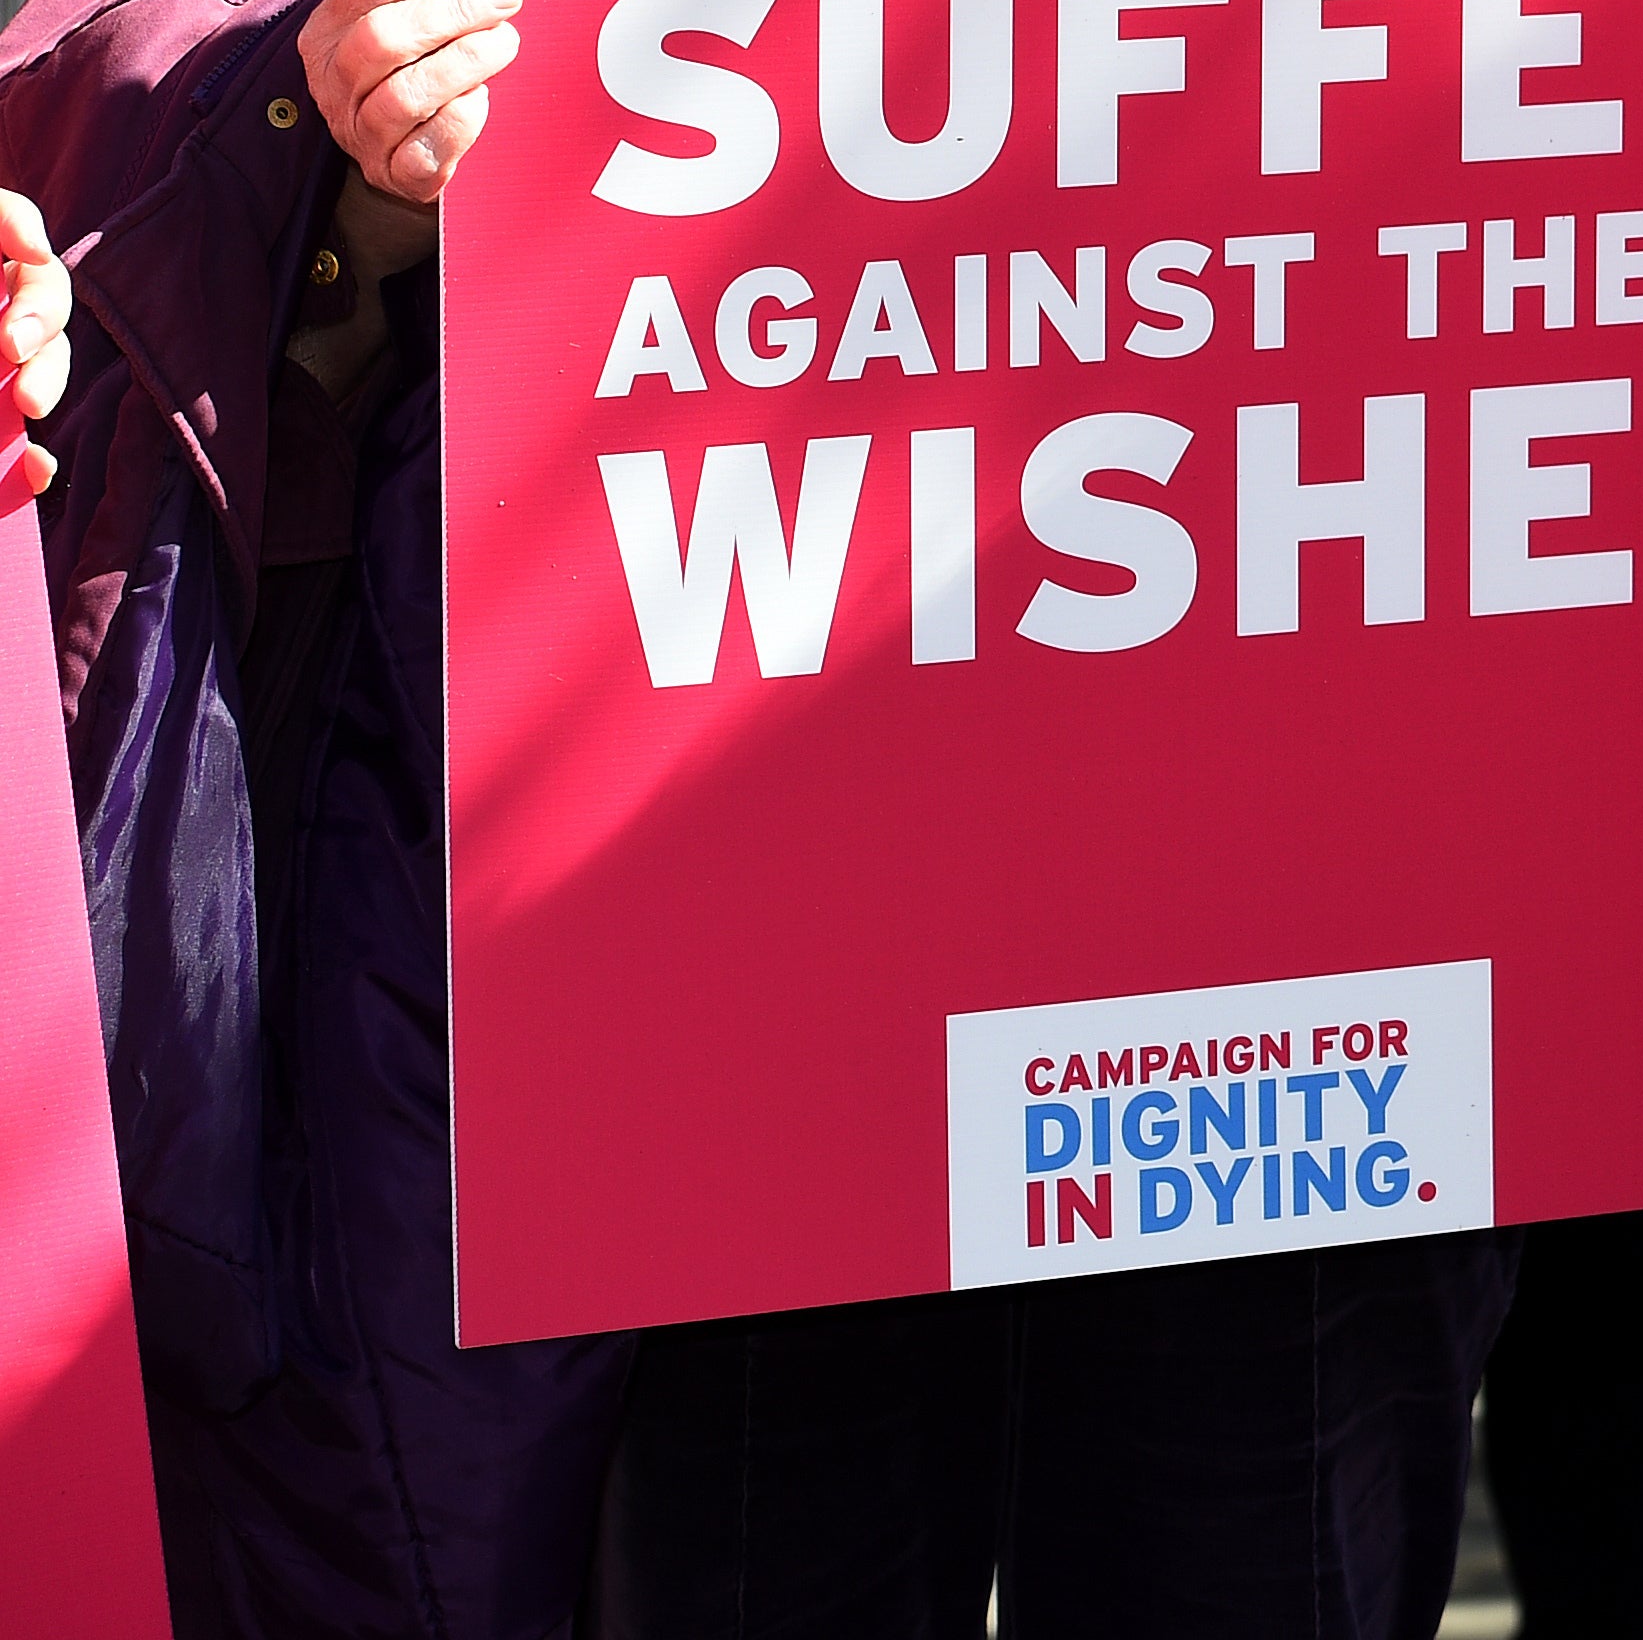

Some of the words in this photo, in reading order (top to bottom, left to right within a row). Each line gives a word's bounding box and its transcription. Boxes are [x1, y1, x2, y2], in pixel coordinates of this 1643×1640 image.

[593, 232, 1314, 398] AGAINST
[1024, 1031, 1291, 1096] CAMPAIGN
[1312, 1019, 1409, 1066] FOR
[1025, 1064, 1408, 1174] DIGNITY
[1026, 1173, 1112, 1248] IN
[1139, 1140, 1437, 1234] DYING.
